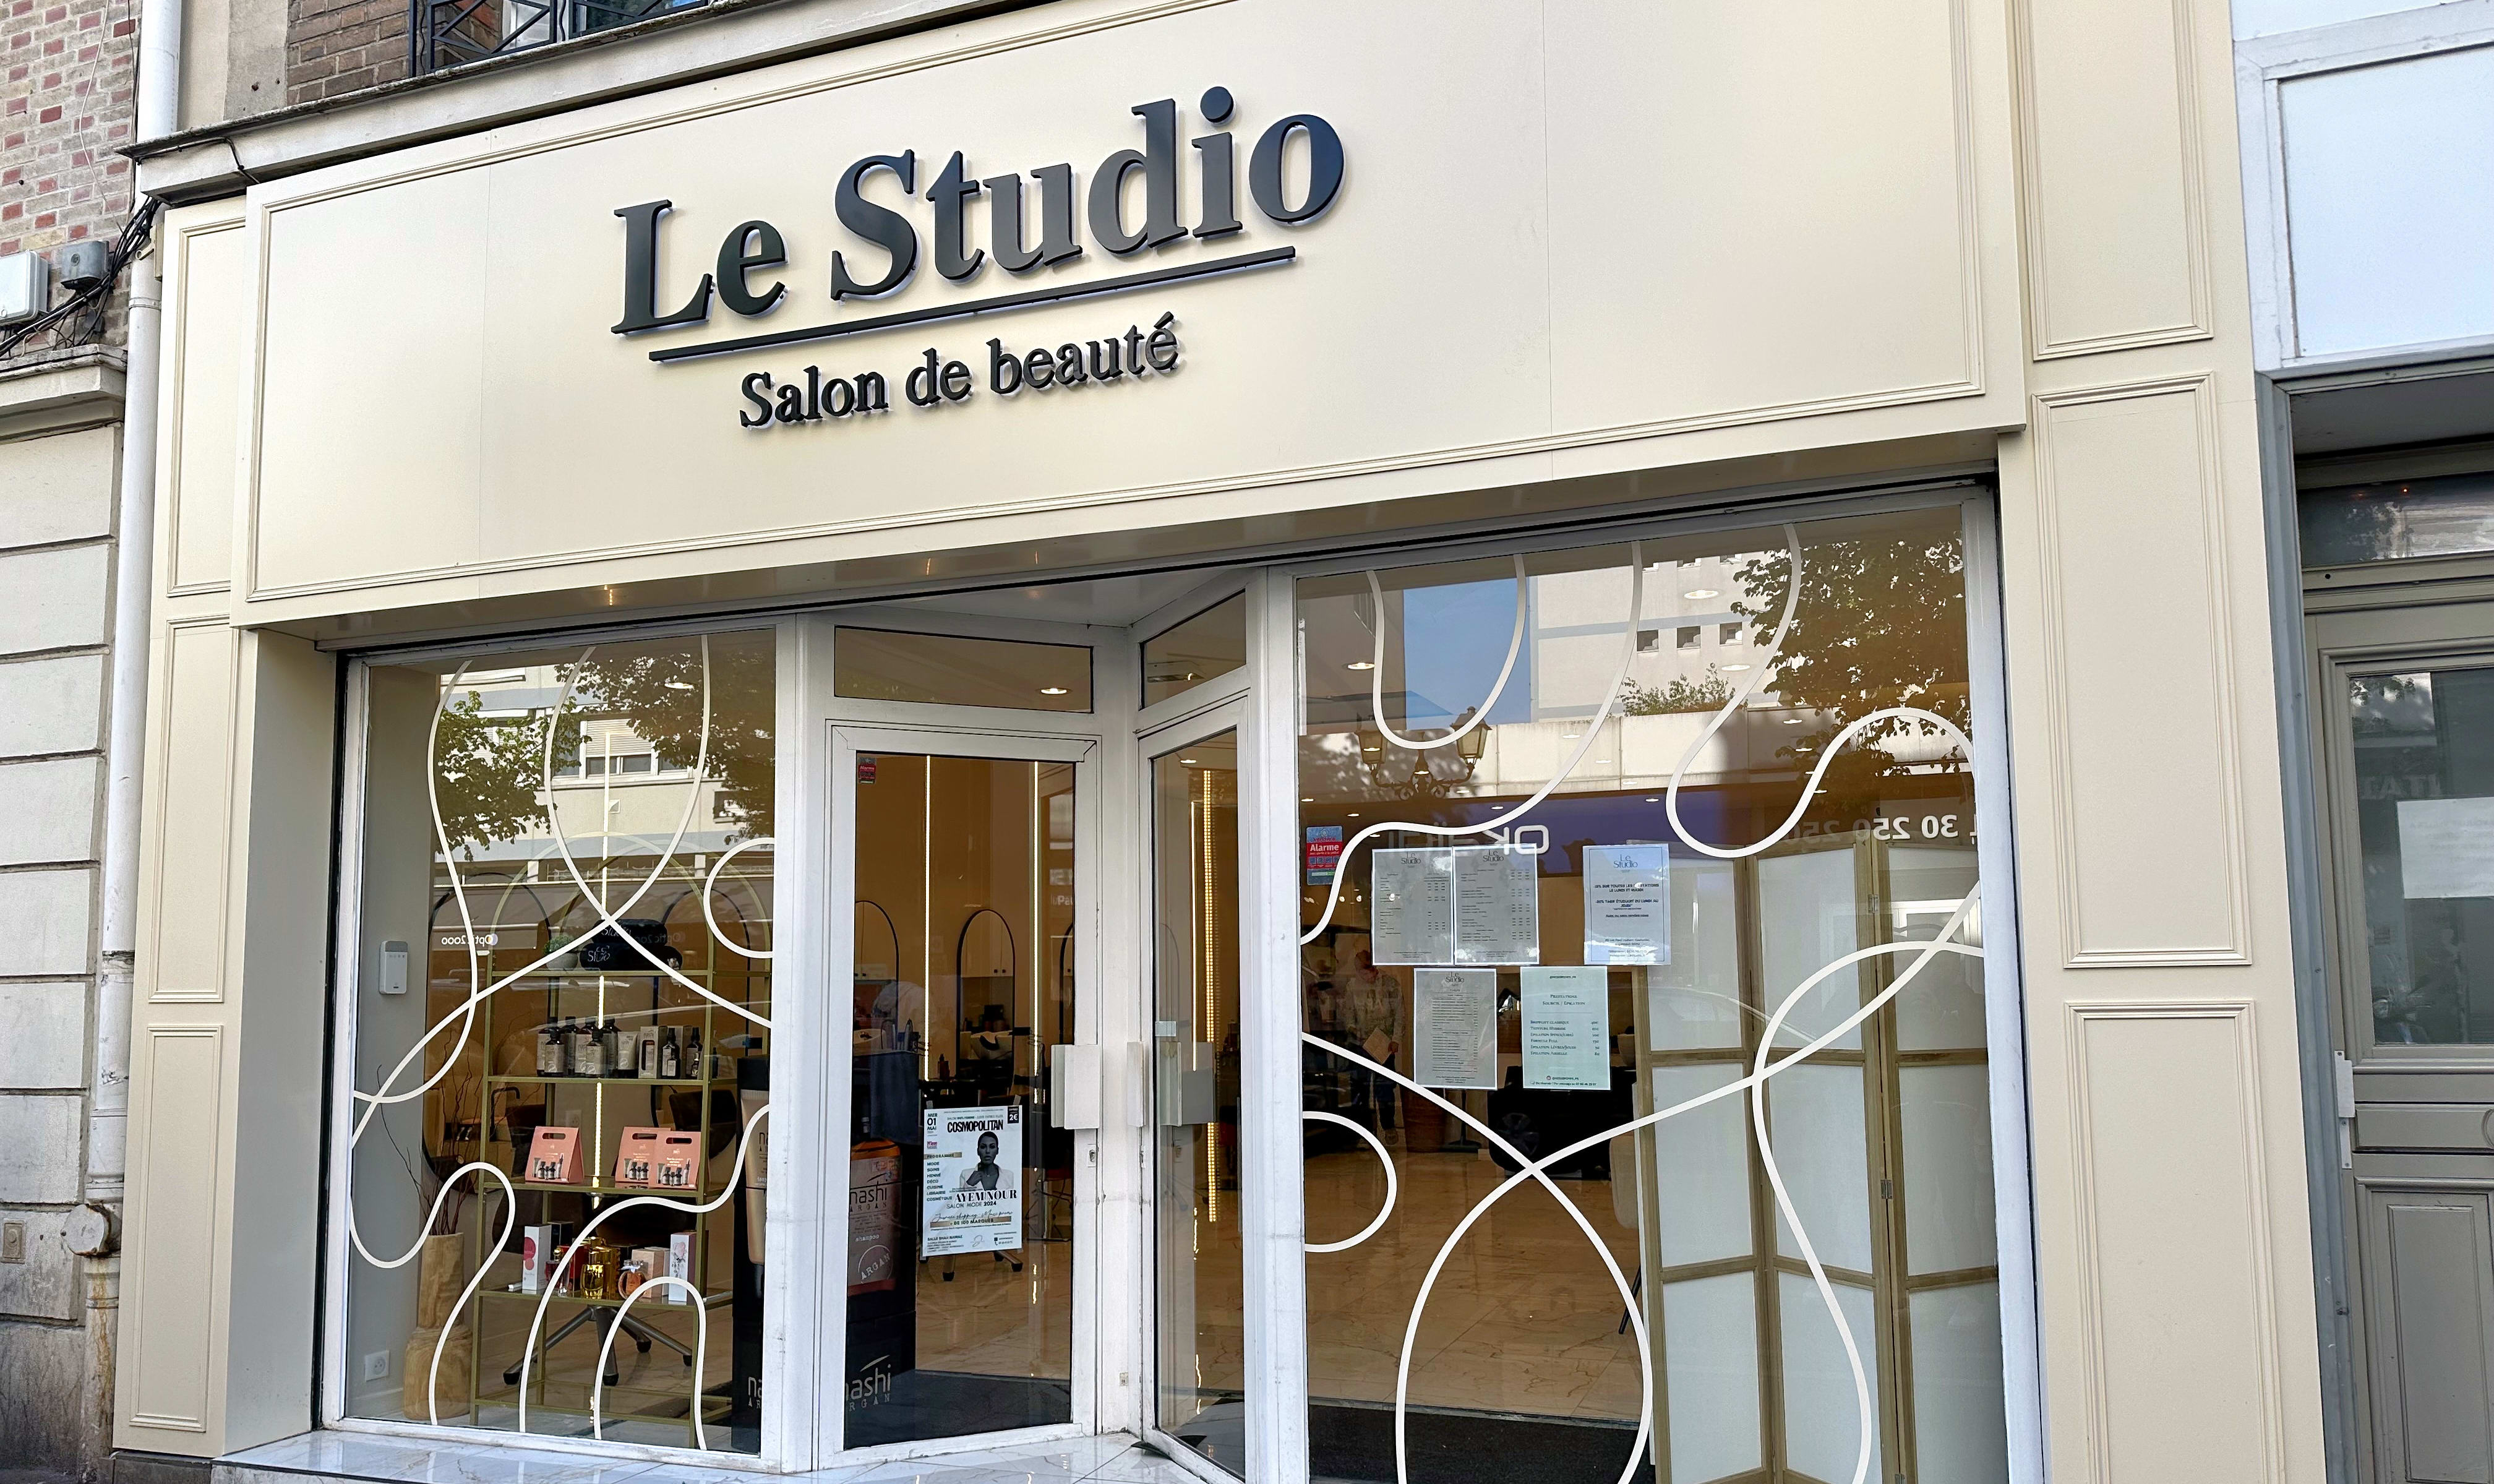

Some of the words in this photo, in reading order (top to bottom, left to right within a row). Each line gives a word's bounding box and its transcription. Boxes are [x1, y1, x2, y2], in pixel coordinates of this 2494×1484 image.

[611, 198, 788, 335] Le
[830, 85, 1347, 302] Studio
[740, 364, 889, 429] Salon
[905, 347, 972, 406] de
[989, 310, 1179, 395] beauté
[1309, 843, 1339, 852] Alarme
[1620, 854, 1631, 862] Le
[927, 1118, 936, 1126] 01
[947, 1120, 1003, 1133] COSMOPOLITAN
[850, 1179, 887, 1205] nashi
[955, 1191, 984, 1203] AYEM
[985, 1190, 1017, 1201] NOUR
[860, 1253, 891, 1282] ARGAN
